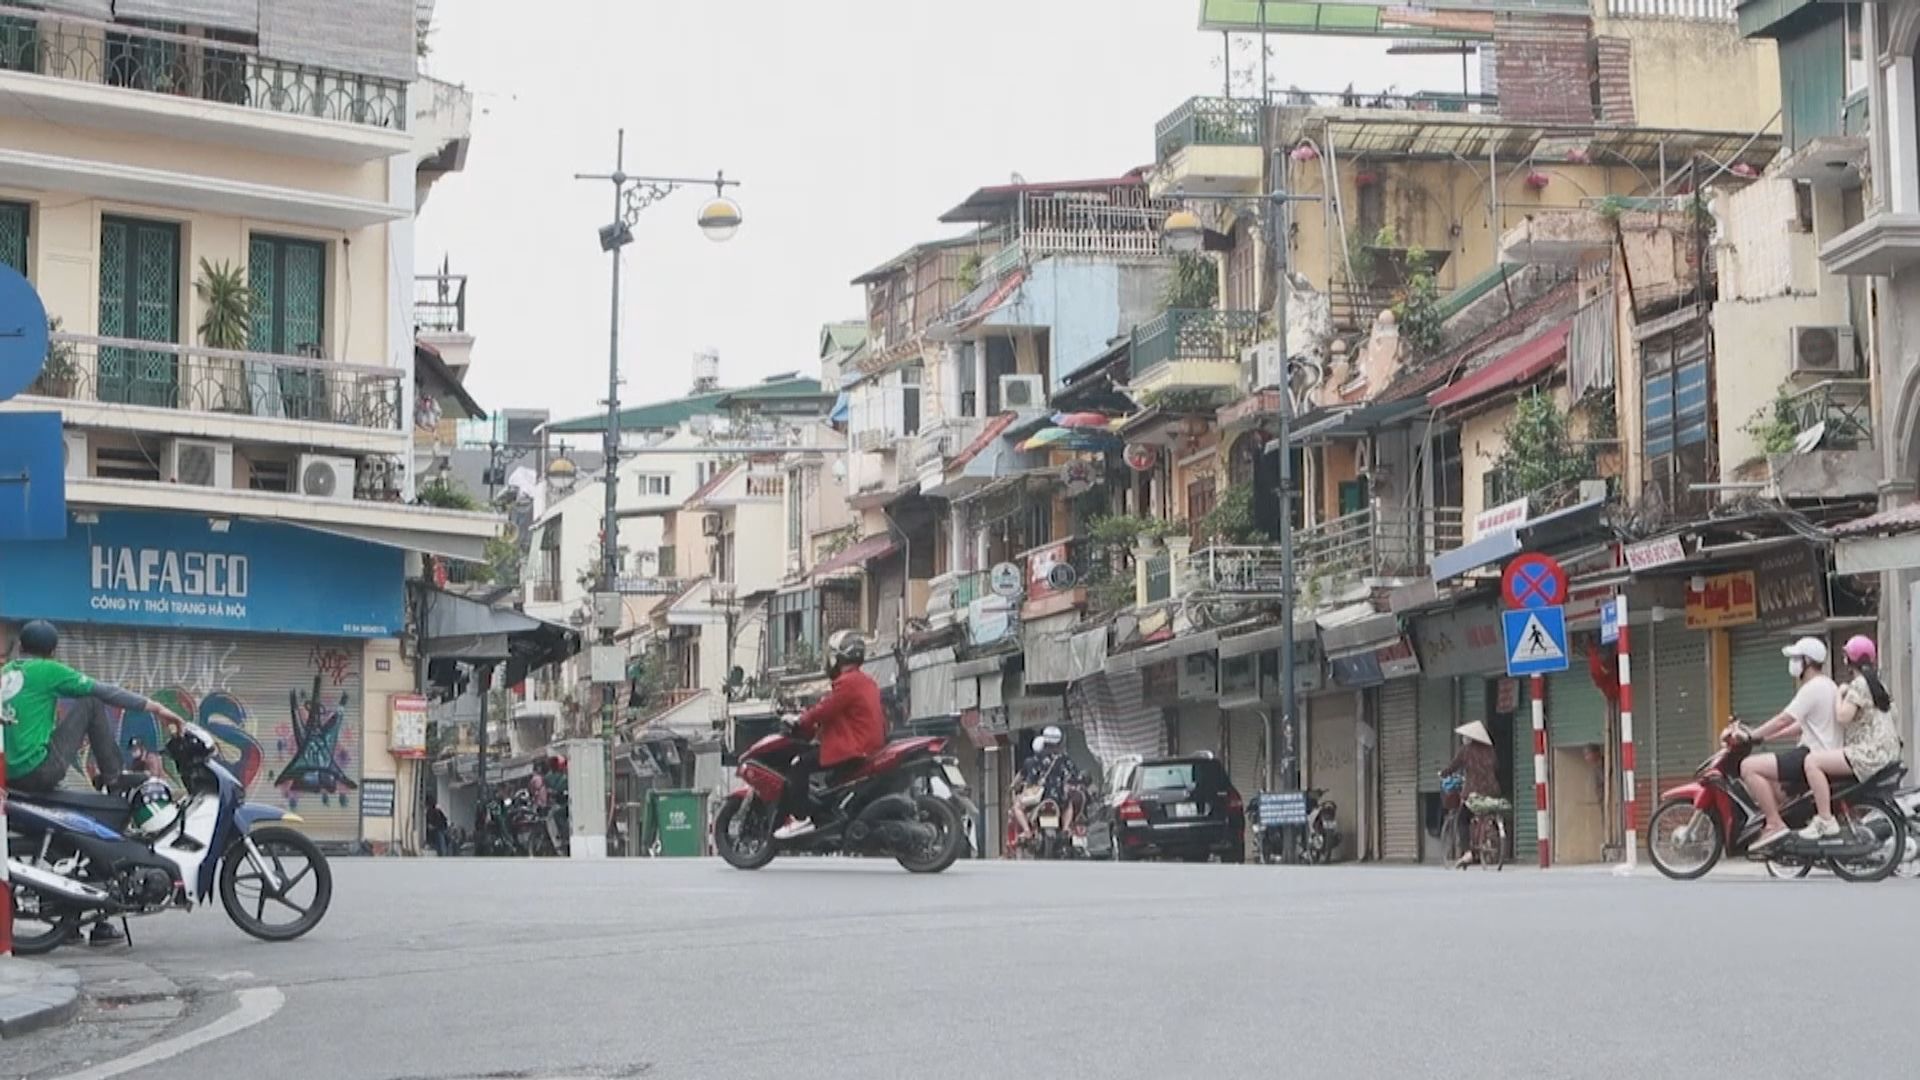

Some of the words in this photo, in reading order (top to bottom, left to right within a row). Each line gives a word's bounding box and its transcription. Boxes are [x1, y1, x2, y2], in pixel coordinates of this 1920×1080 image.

[91, 545, 248, 598] HAFASCO
[91, 594, 127, 611] CÔNG
[128, 598, 140, 611] TY
[171, 601, 206, 615] TRANG
[208, 600, 224, 616] HÀ
[226, 602, 246, 619] NỘI
